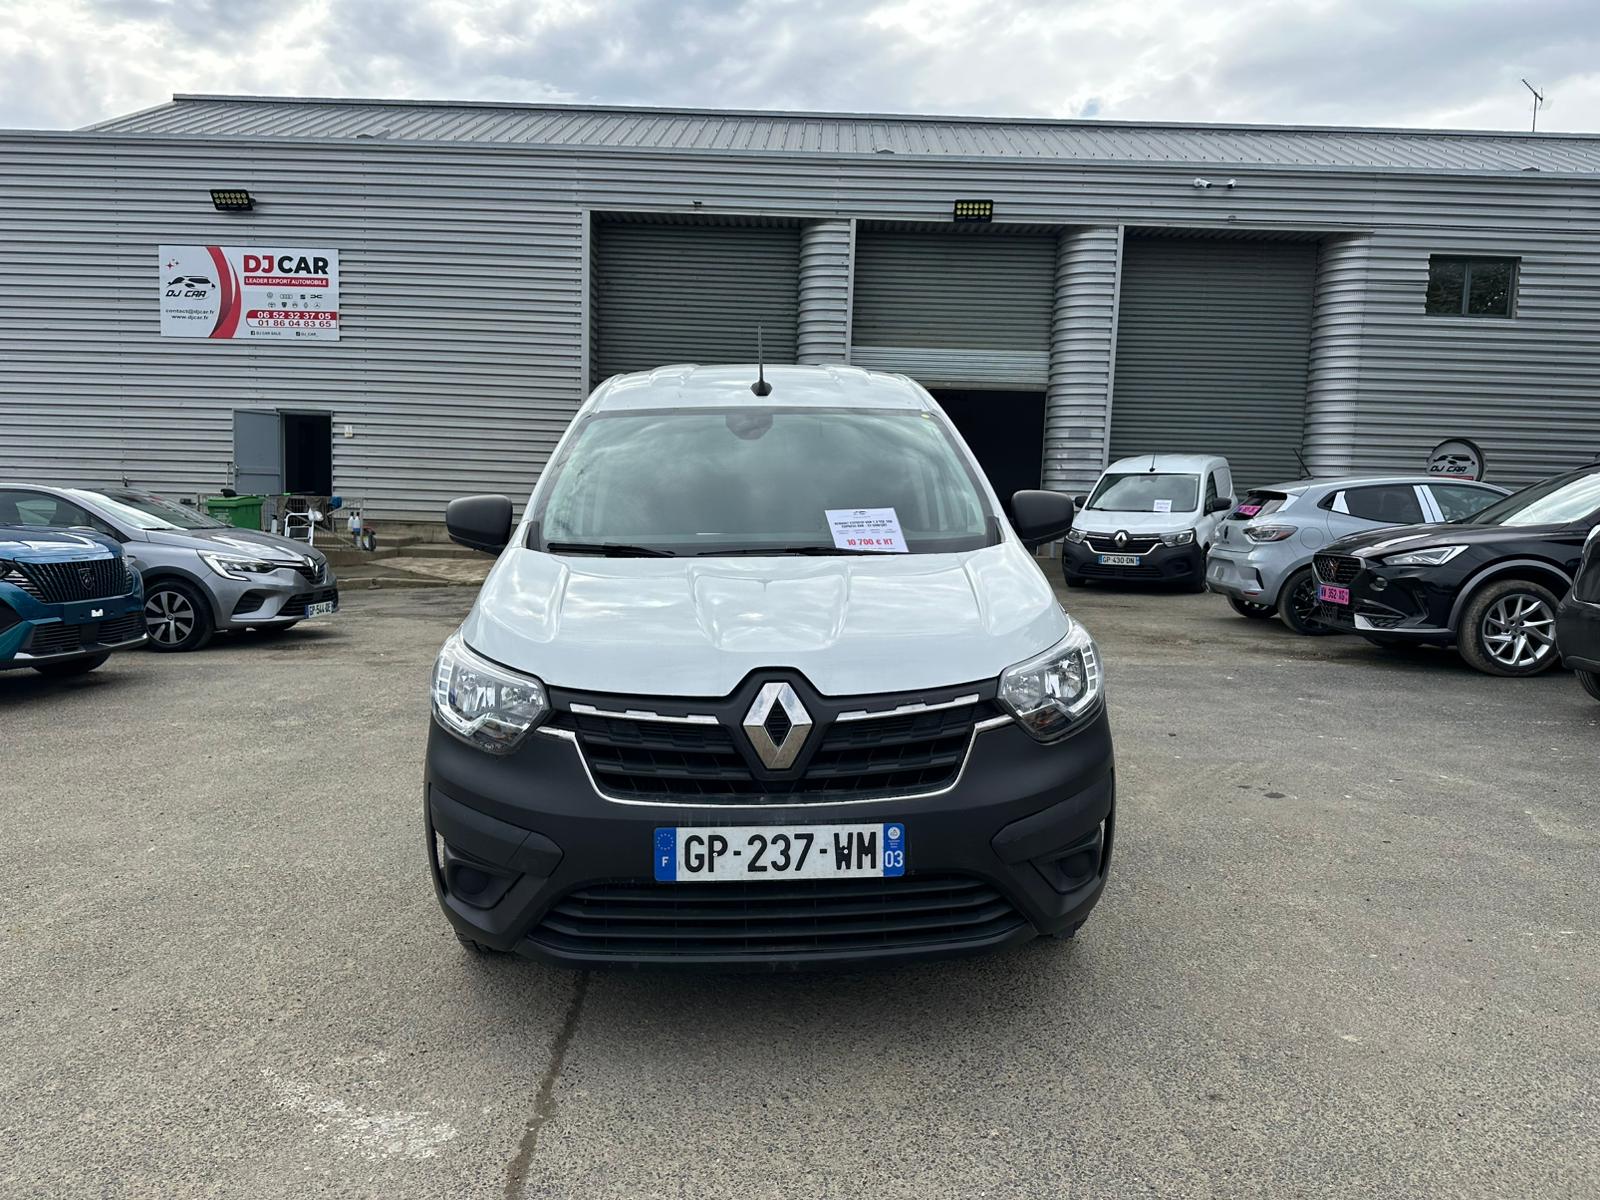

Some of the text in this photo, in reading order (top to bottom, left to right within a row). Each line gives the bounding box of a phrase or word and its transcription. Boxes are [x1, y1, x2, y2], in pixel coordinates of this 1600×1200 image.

[243, 255, 329, 274] DJ CAR
[184, 290, 207, 298] CAR
[257, 311, 270, 319] 06
[273, 311, 285, 319] 52
[303, 312, 316, 320] 37
[318, 320, 332, 328] 65
[858, 538, 874, 546] 700
[684, 831, 877, 873] GP-237-WM
[662, 856, 669, 867] F
[885, 850, 903, 868] 03
